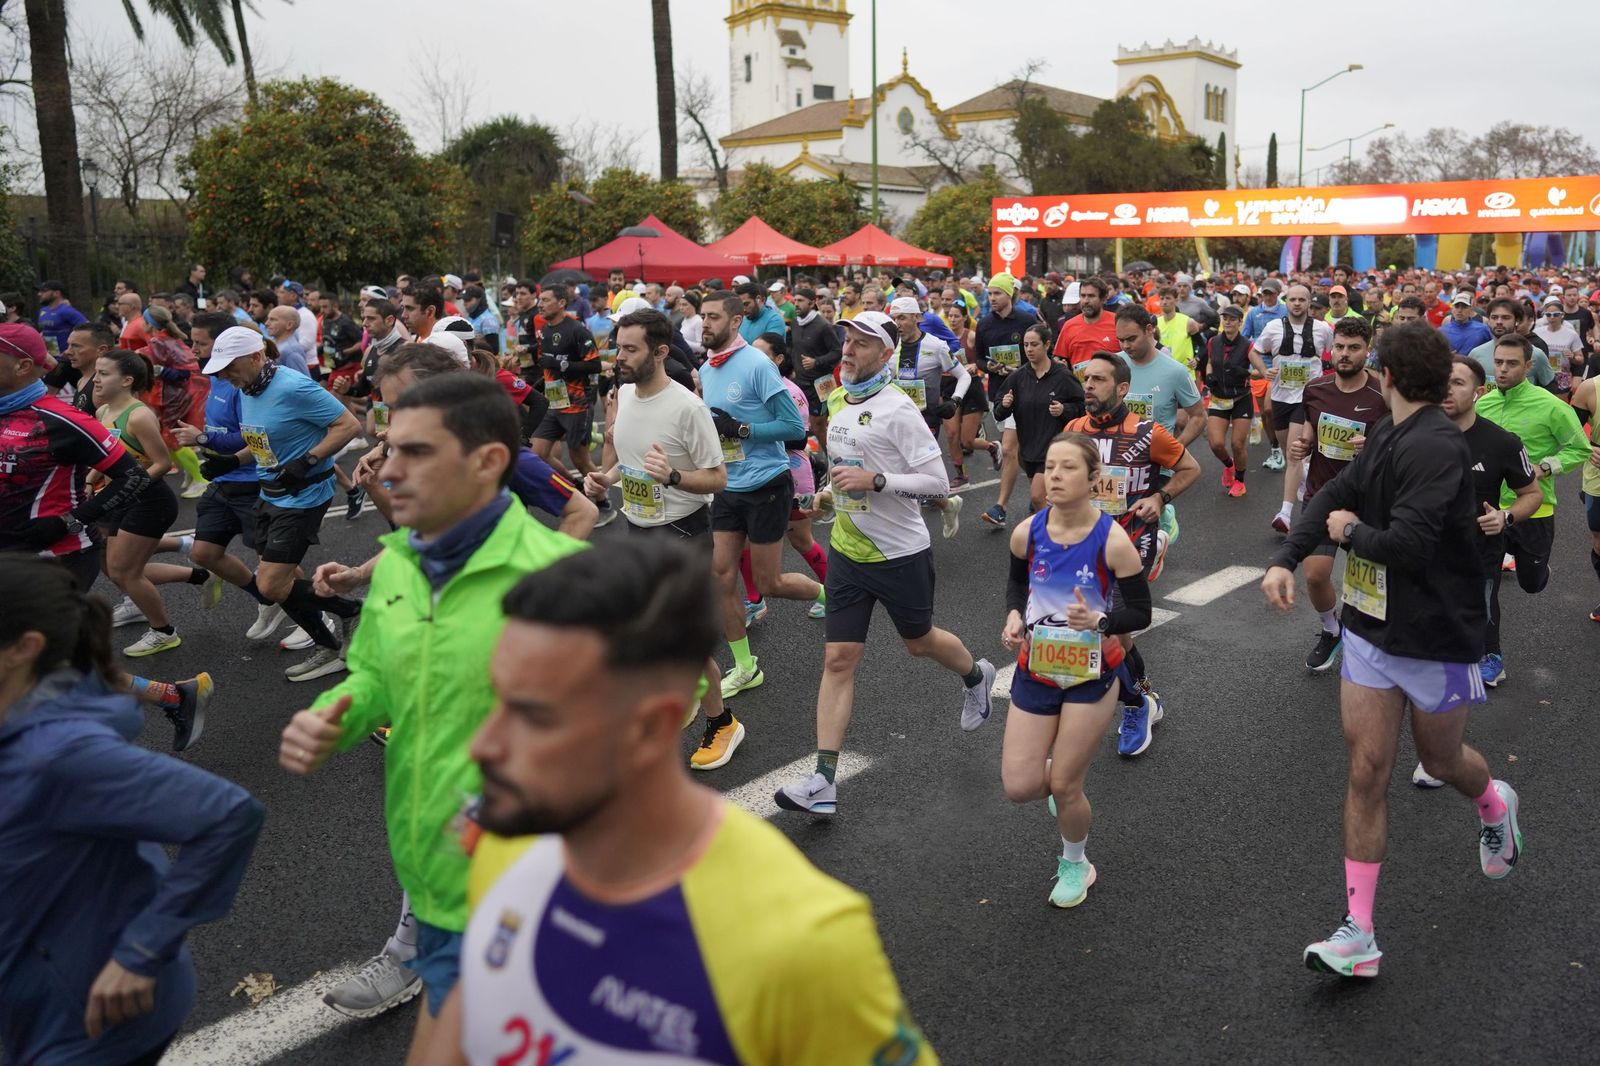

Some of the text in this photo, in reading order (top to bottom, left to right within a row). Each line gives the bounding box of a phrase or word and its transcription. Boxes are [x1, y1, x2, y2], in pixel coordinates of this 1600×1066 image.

[1412, 198, 1467, 216] HOKA
[624, 478, 649, 498] 9228
[1036, 642, 1089, 667] 10455
